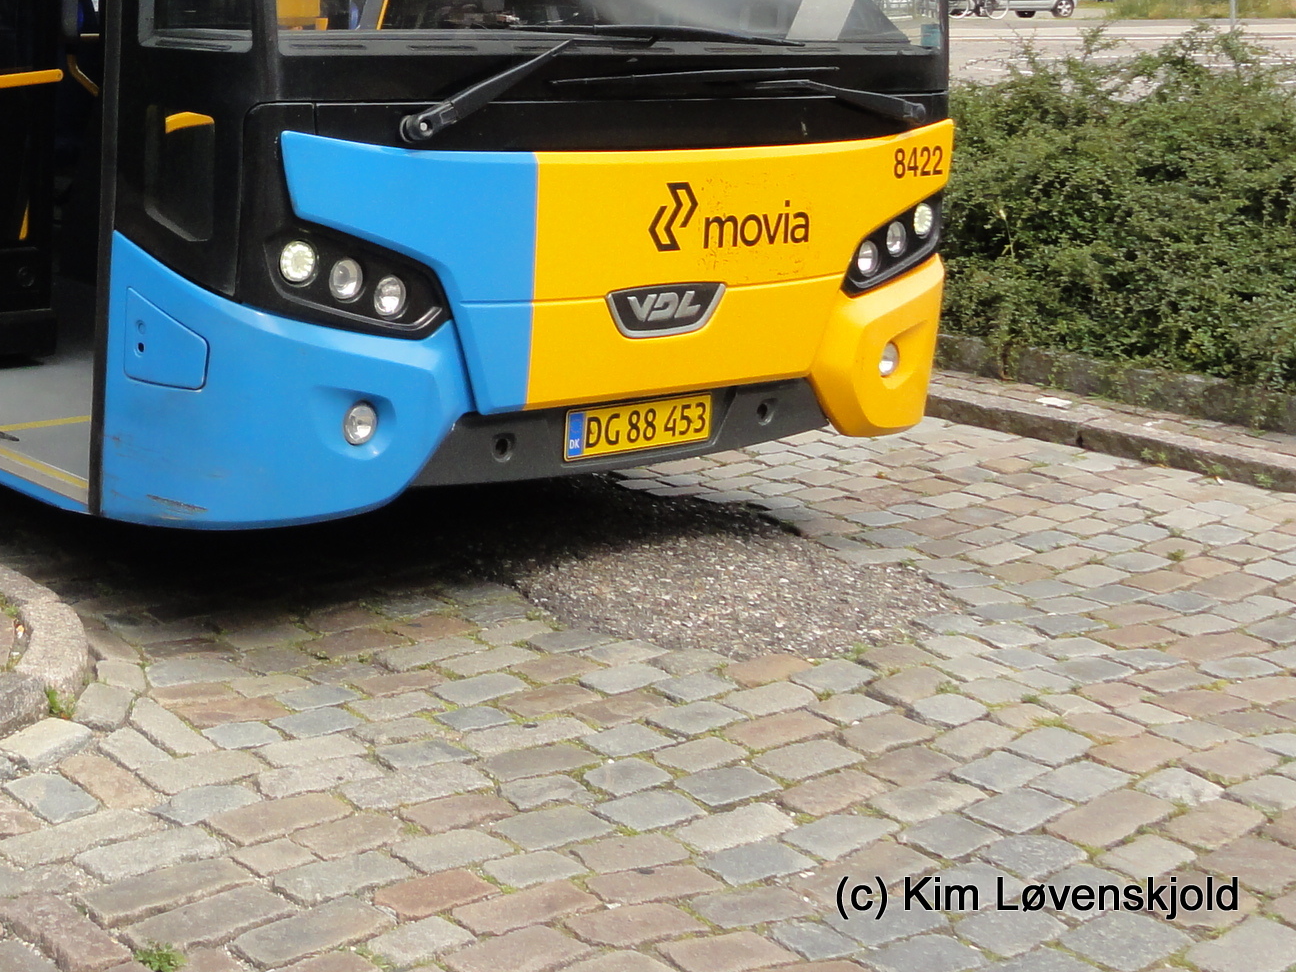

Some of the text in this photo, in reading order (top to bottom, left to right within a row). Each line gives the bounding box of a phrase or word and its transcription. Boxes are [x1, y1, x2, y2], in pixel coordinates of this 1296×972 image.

[893, 145, 944, 180] 8422
[702, 199, 811, 249] movia
[626, 290, 702, 323] VDL
[585, 401, 707, 449] DG 88 453
[568, 439, 580, 450] DK
